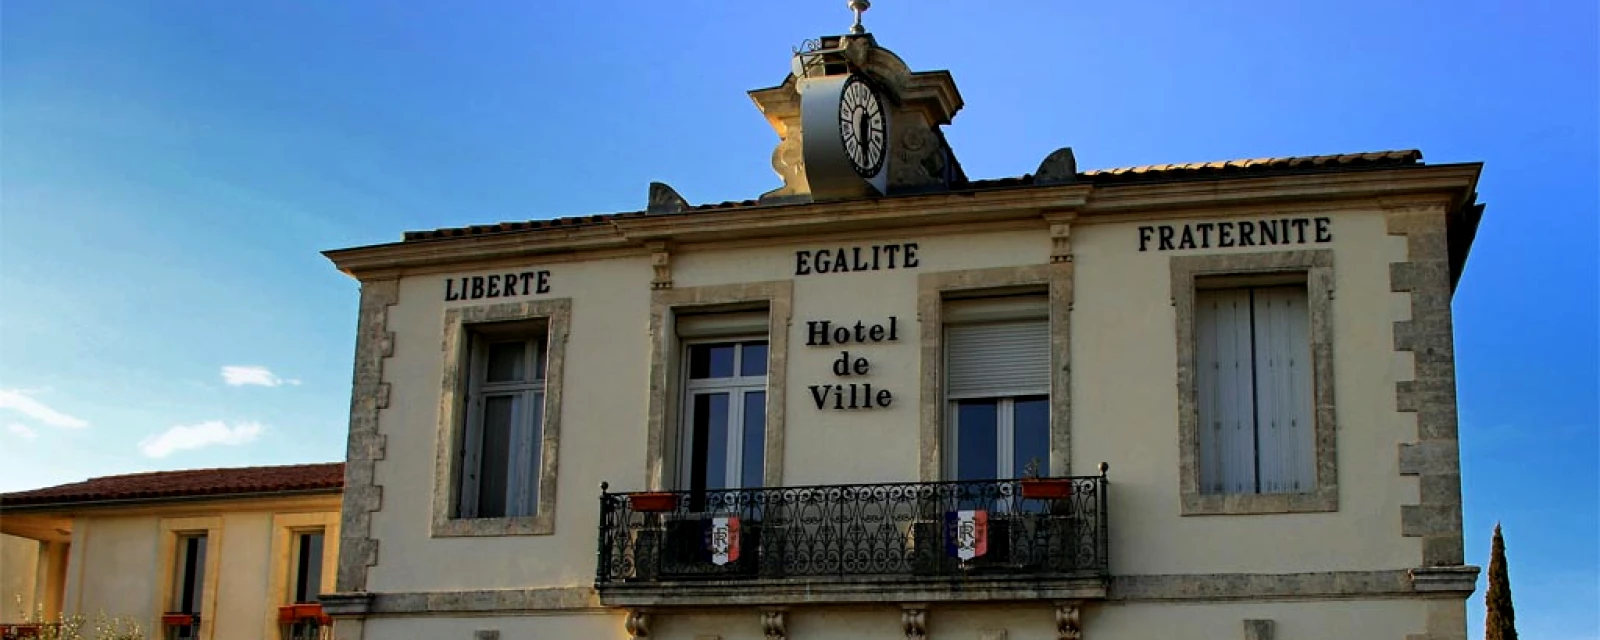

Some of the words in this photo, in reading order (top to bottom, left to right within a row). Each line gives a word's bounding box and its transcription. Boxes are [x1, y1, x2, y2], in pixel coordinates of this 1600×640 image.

[1138, 216, 1332, 251] FRATERNITE
[795, 242, 920, 275] EGALITE
[445, 270, 550, 302] LIBERTE
[806, 317, 898, 346] Hotel
[832, 351, 869, 377] de
[809, 384, 893, 410] Ville
